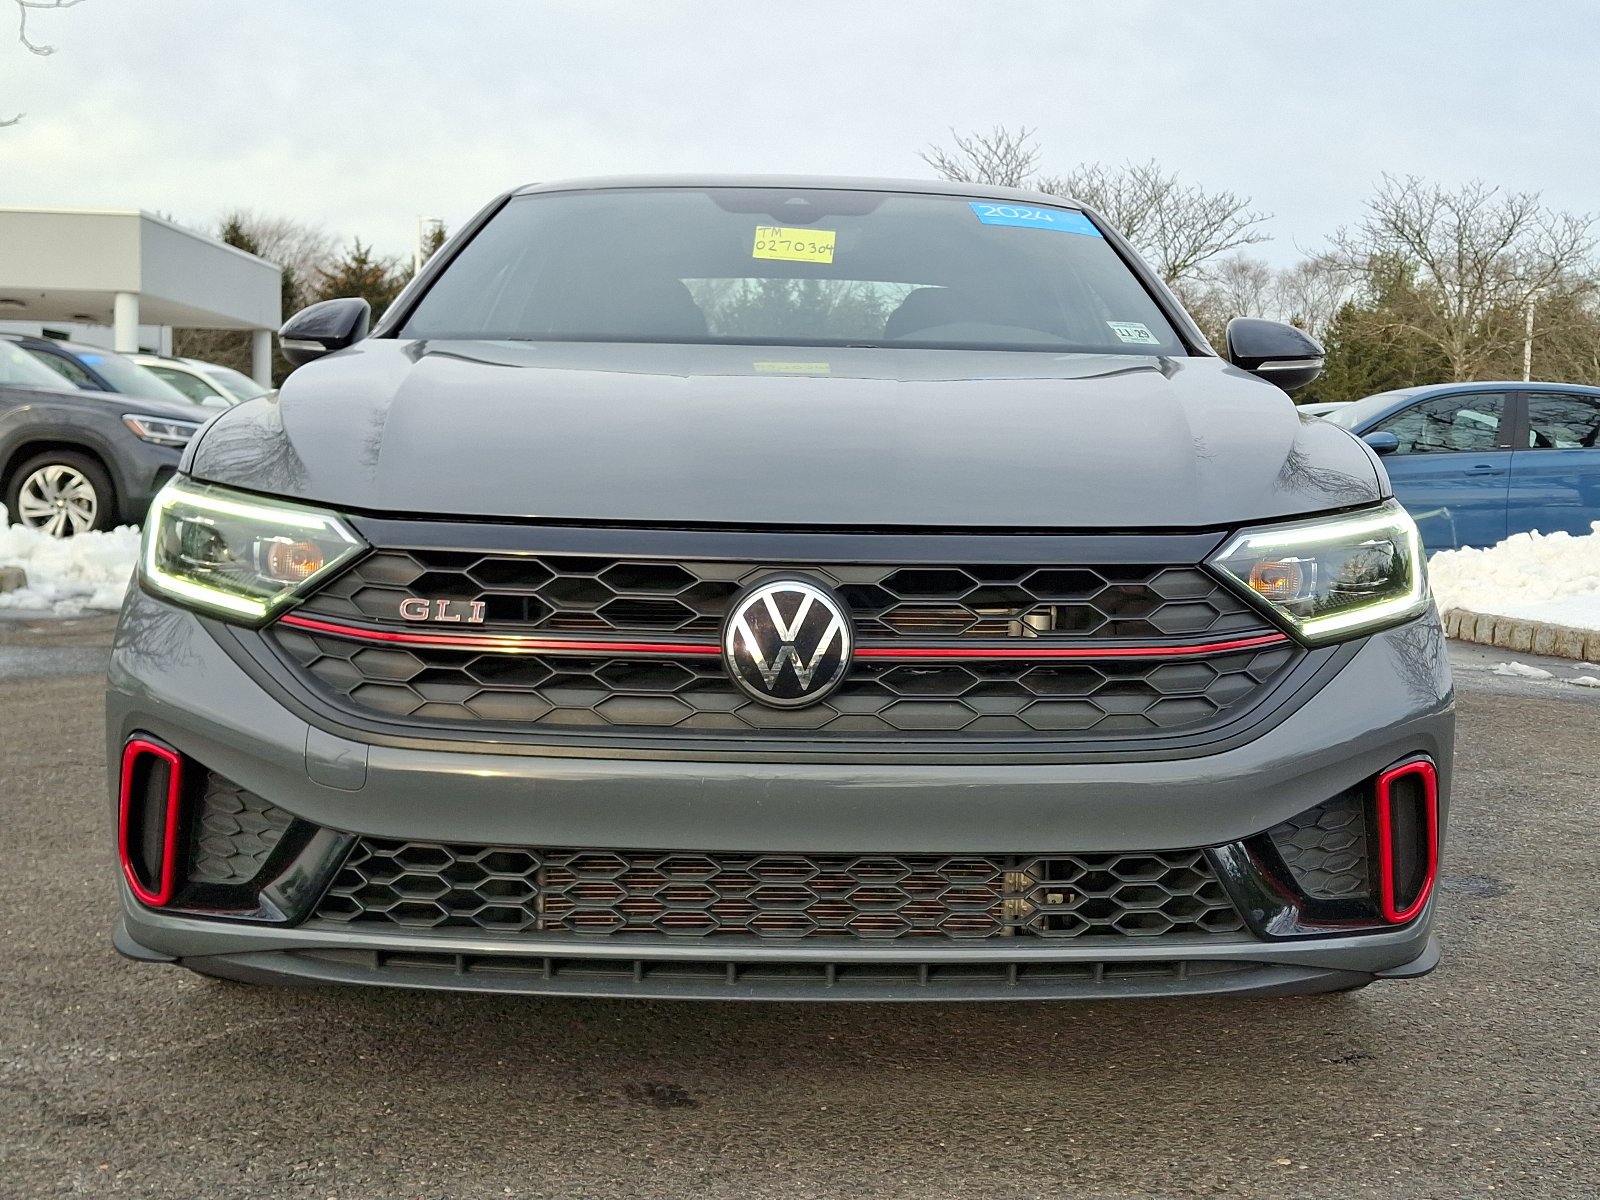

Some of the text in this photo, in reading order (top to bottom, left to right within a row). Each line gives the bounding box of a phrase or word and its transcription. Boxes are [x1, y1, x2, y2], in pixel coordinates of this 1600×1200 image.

[978, 204, 1054, 222] 2024
[757, 227, 782, 238] TM
[755, 239, 834, 257] 0270304
[399, 597, 486, 623] GLI
[732, 587, 844, 693] VW
